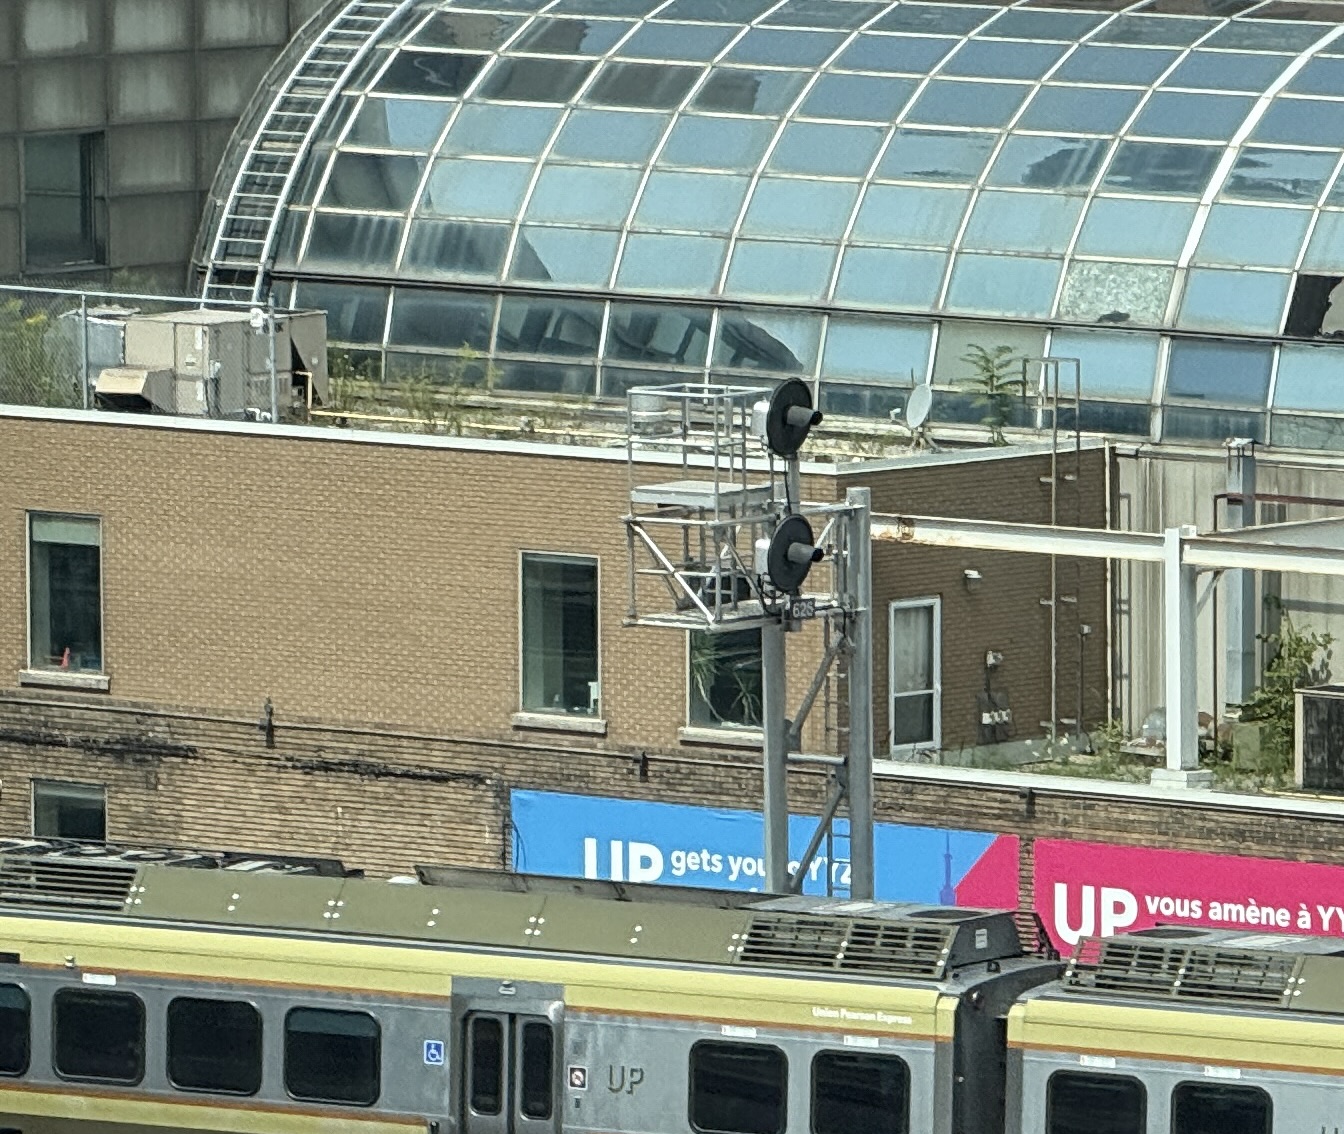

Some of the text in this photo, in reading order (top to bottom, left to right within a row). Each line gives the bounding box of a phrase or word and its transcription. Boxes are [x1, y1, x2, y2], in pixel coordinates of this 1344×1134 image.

[584, 837, 664, 882] UP
[671, 849, 723, 877] gets
[1054, 882, 1138, 945] UP
[1145, 895, 1202, 919] vous
[1208, 898, 1290, 927] amène
[1298, 903, 1312, 930] à
[812, 1006, 913, 1025] Union Pearson Express
[608, 1064, 645, 1095] UP
